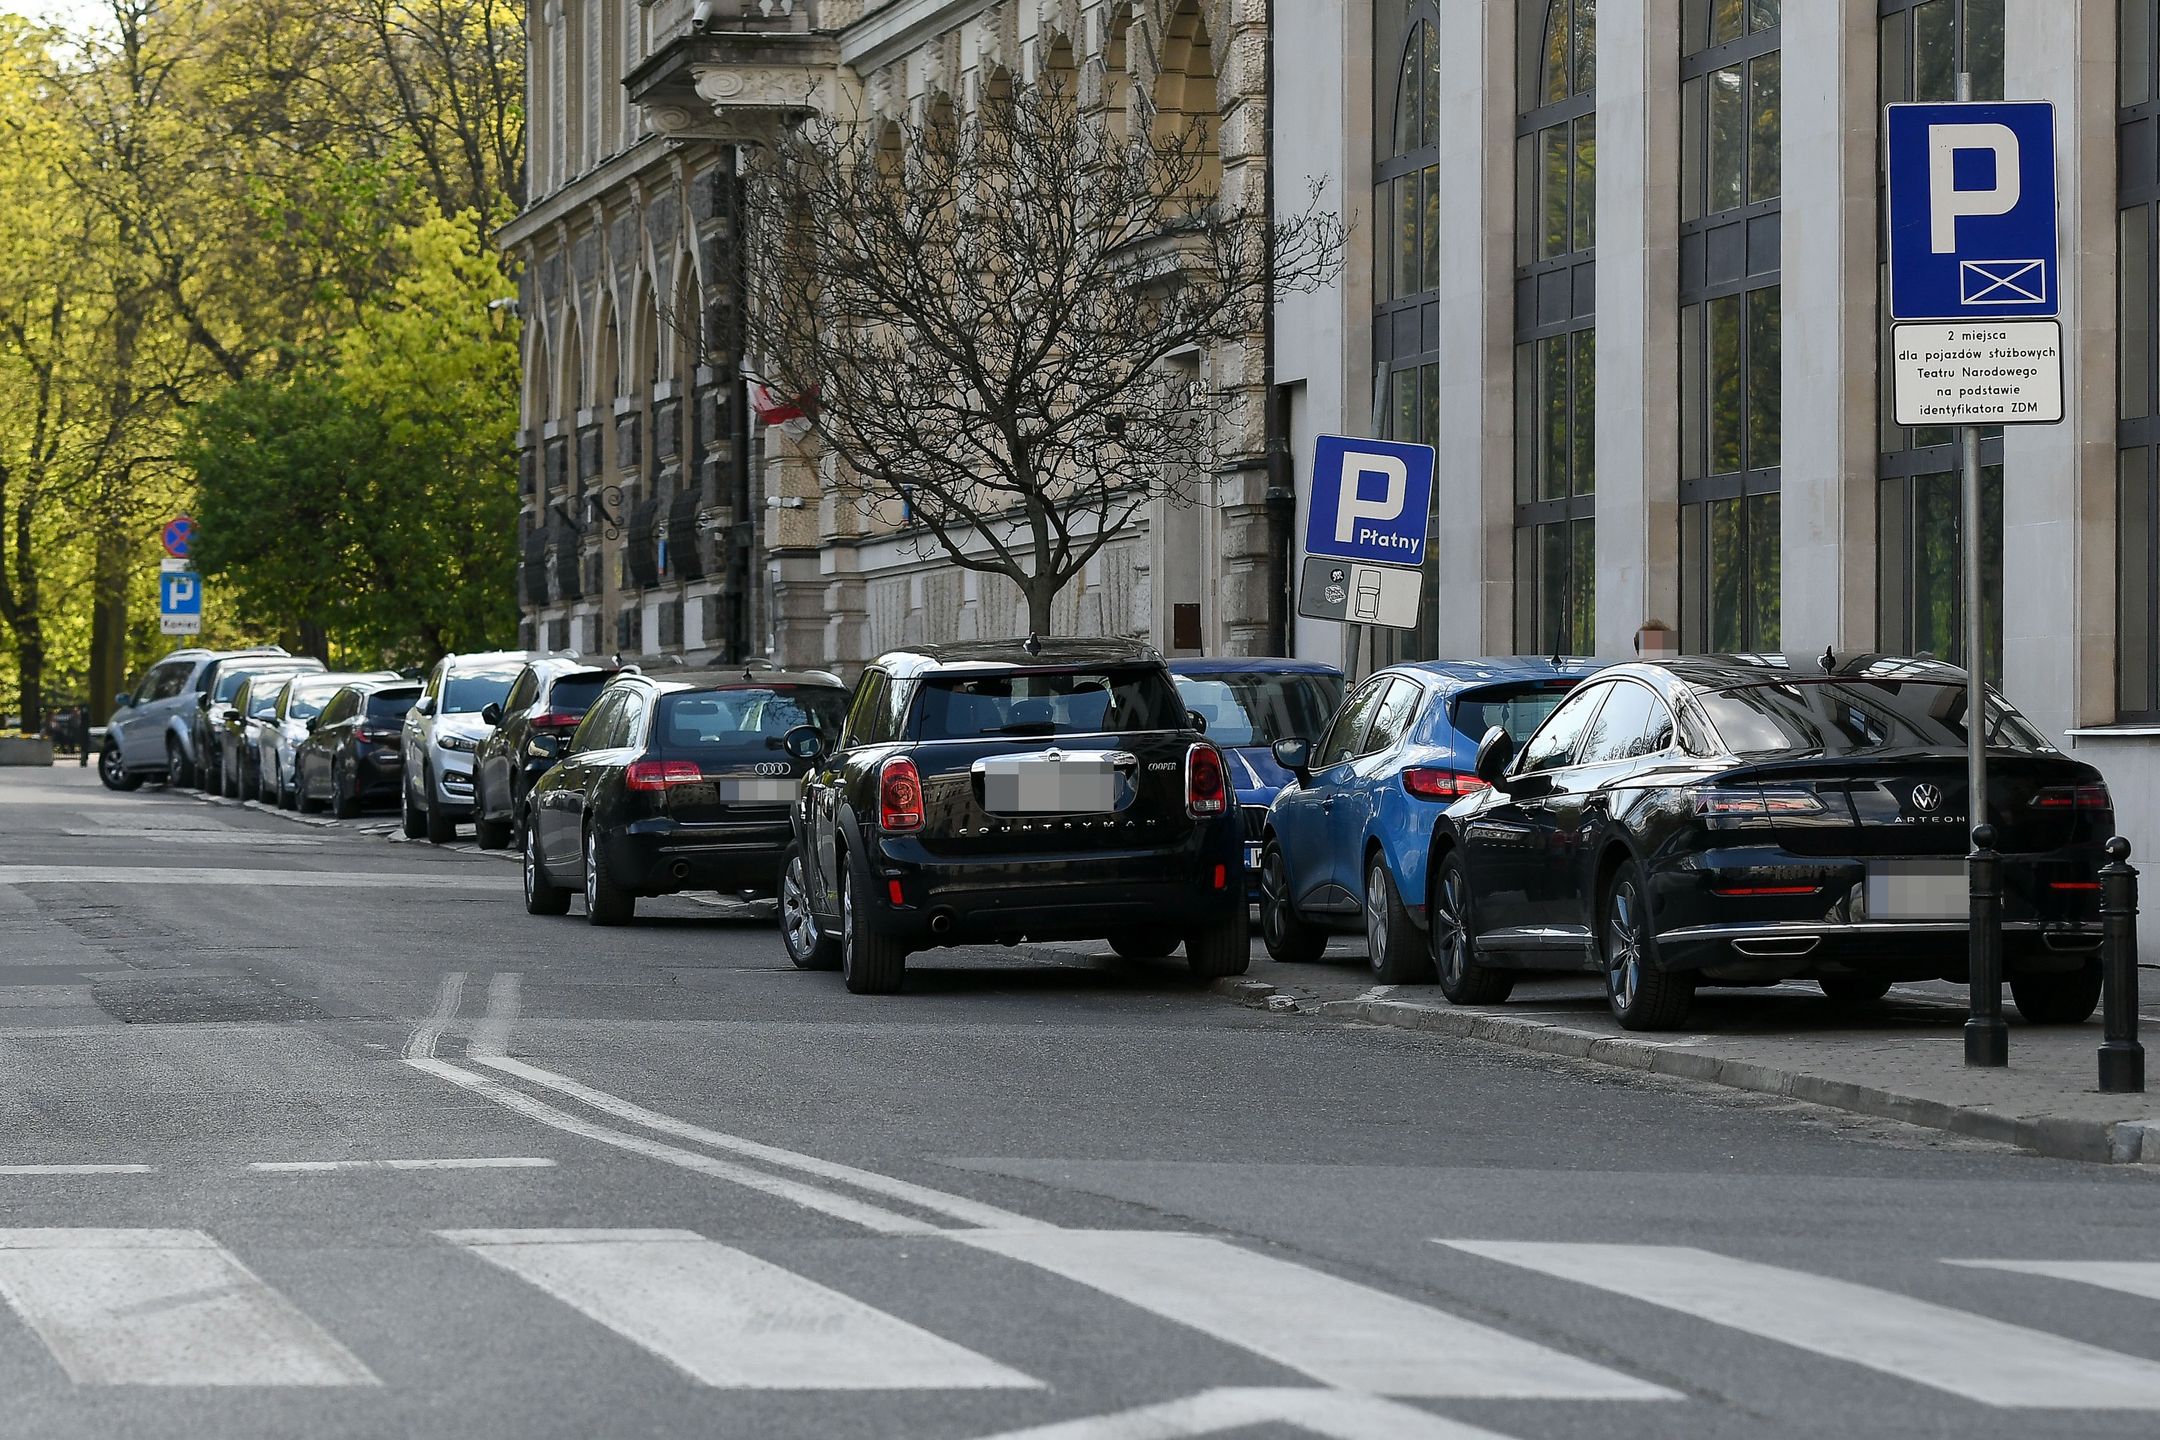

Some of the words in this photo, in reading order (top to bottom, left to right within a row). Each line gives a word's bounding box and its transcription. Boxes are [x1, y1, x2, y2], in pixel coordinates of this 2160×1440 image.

[1929, 123, 2020, 254] P
[1947, 330, 1955, 341] 2
[1962, 330, 2007, 342] miejsca
[1899, 350, 1918, 361] dla
[1925, 348, 1982, 362] pojazdów
[1988, 347, 2056, 360] służbowych
[1917, 368, 1955, 378] Teatru
[1962, 366, 2038, 378] Narodowego
[1936, 388, 1952, 396] na
[1959, 384, 2021, 398] podstawie
[1919, 404, 2004, 417] identyfikatora
[2011, 402, 2038, 413] ZDM
[1334, 451, 1407, 543] P
[1359, 528, 1420, 554] Płatny
[169, 576, 193, 610] P
[1147, 762, 1177, 772] COOPER
[959, 819, 1156, 834] COUNTRYMAN
[1894, 816, 1965, 824] ARTEON
